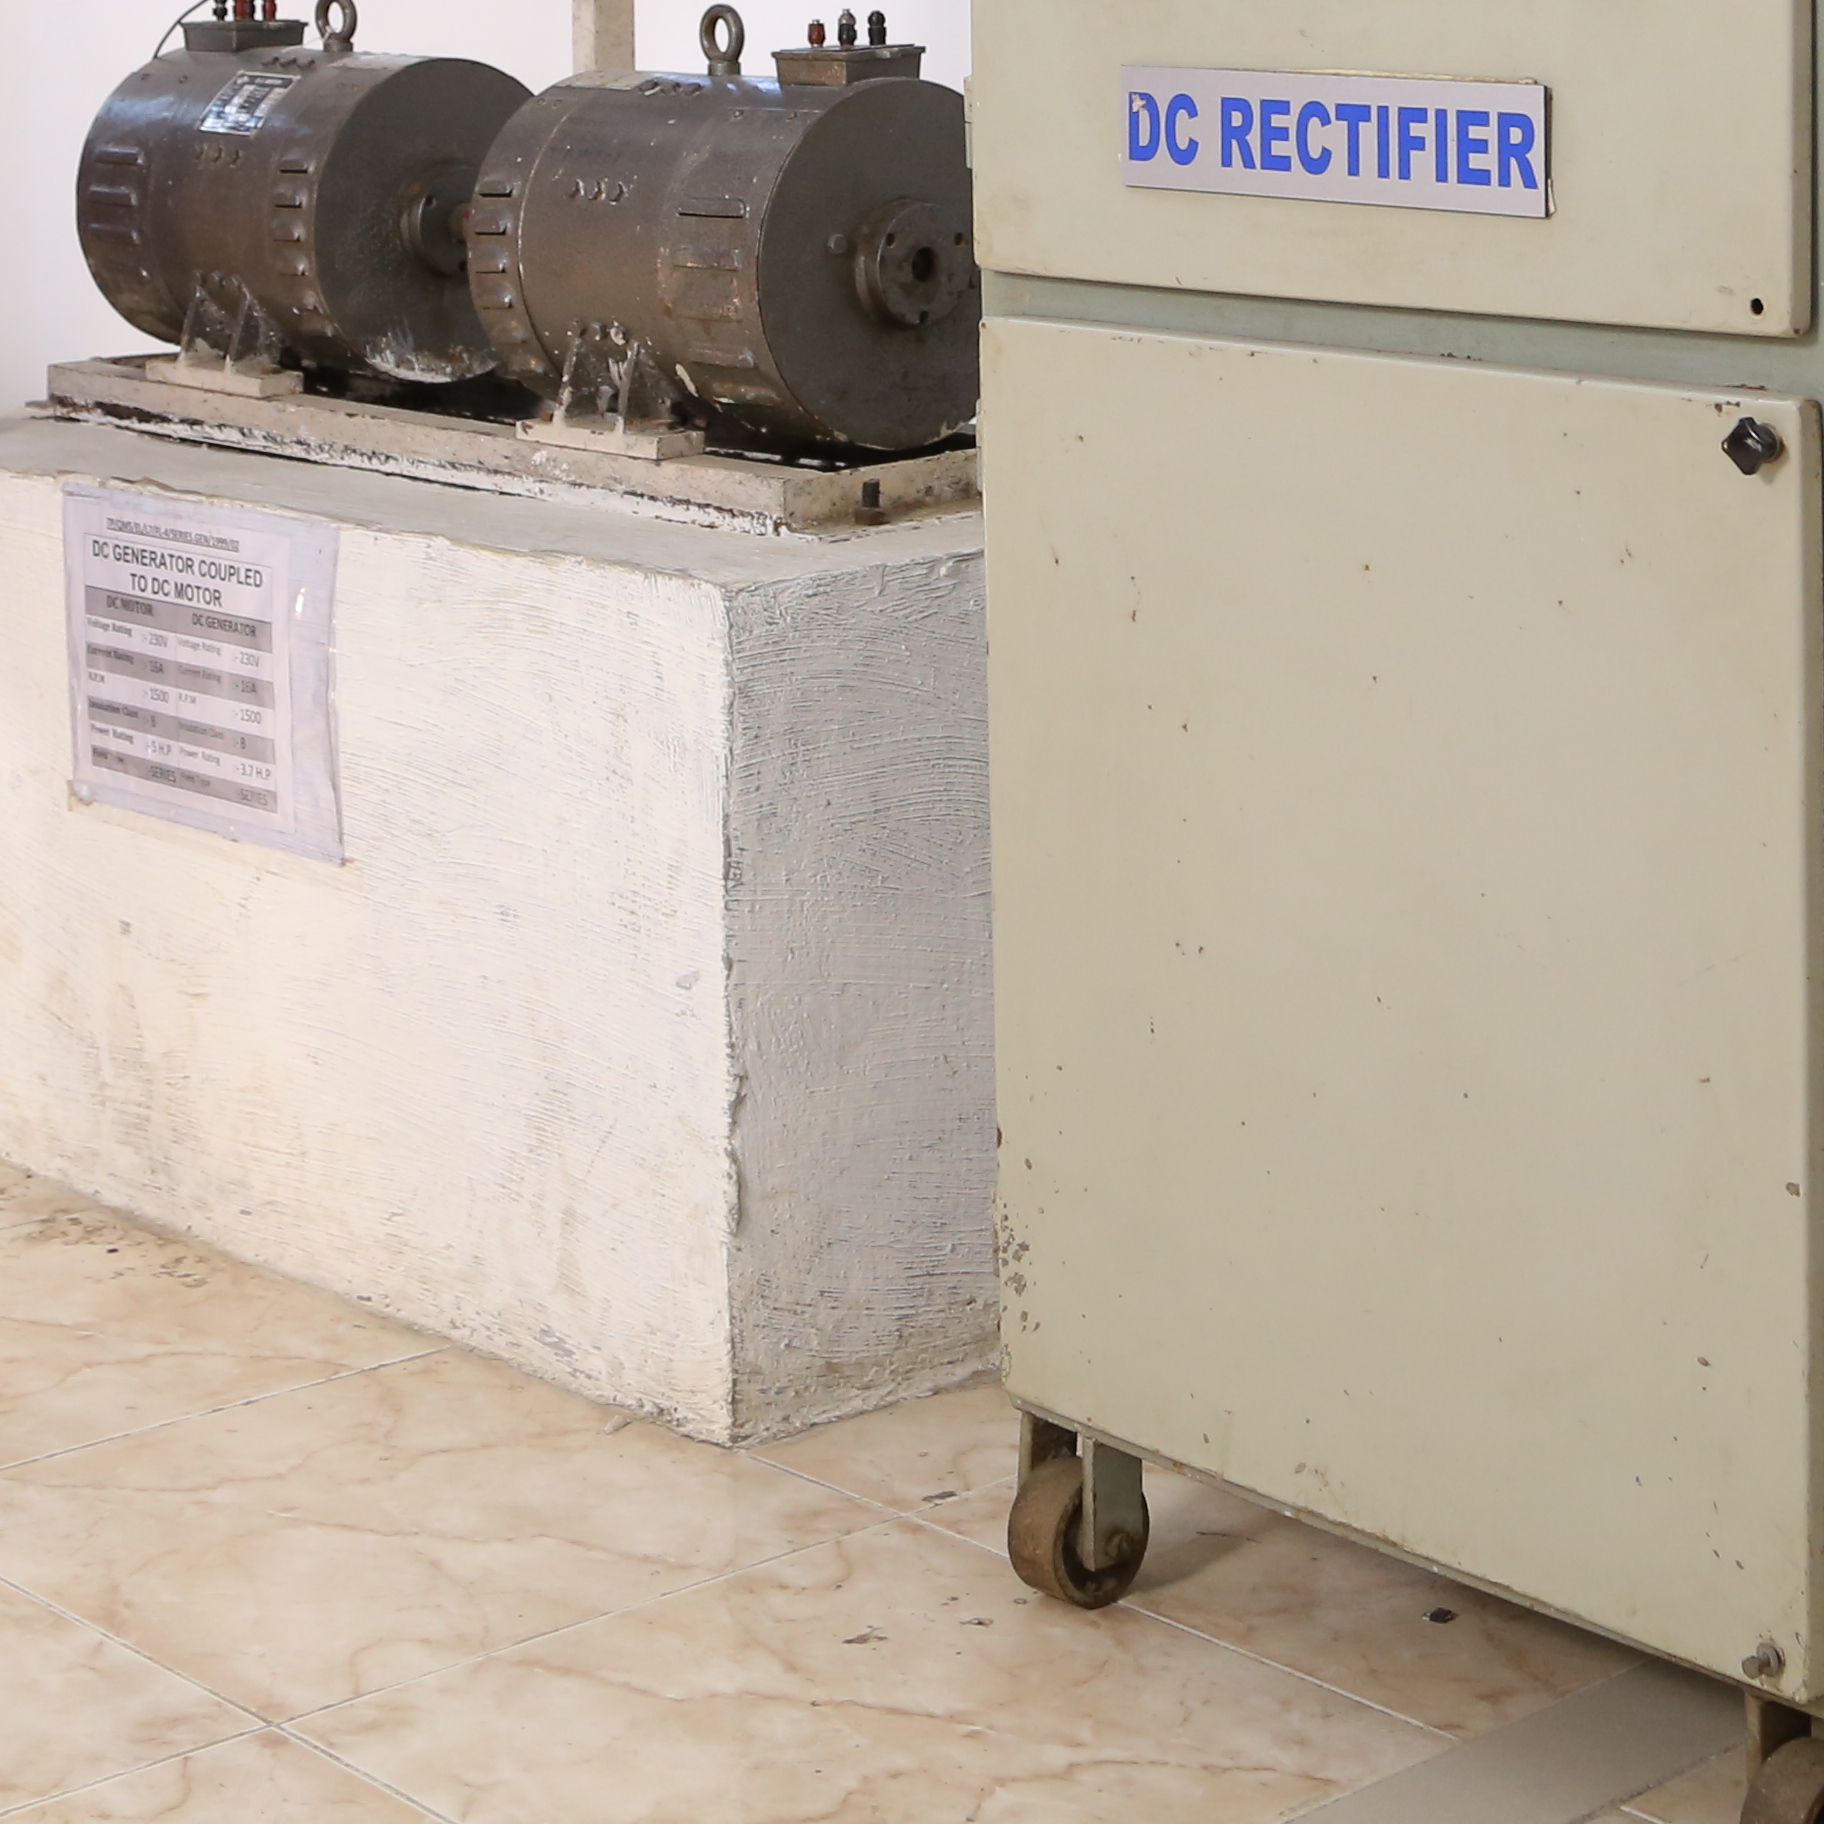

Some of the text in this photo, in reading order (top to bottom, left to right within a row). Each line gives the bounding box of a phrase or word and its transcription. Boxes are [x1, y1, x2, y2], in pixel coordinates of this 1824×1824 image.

[1128, 90, 1539, 191] DC RECTIFIER
[92, 540, 263, 588] DC GENERATOR COUPLED
[106, 594, 153, 616] DC MOTOR
[130, 573, 222, 607] TO DC MOTOR
[191, 612, 256, 638] DC GENERATOR
